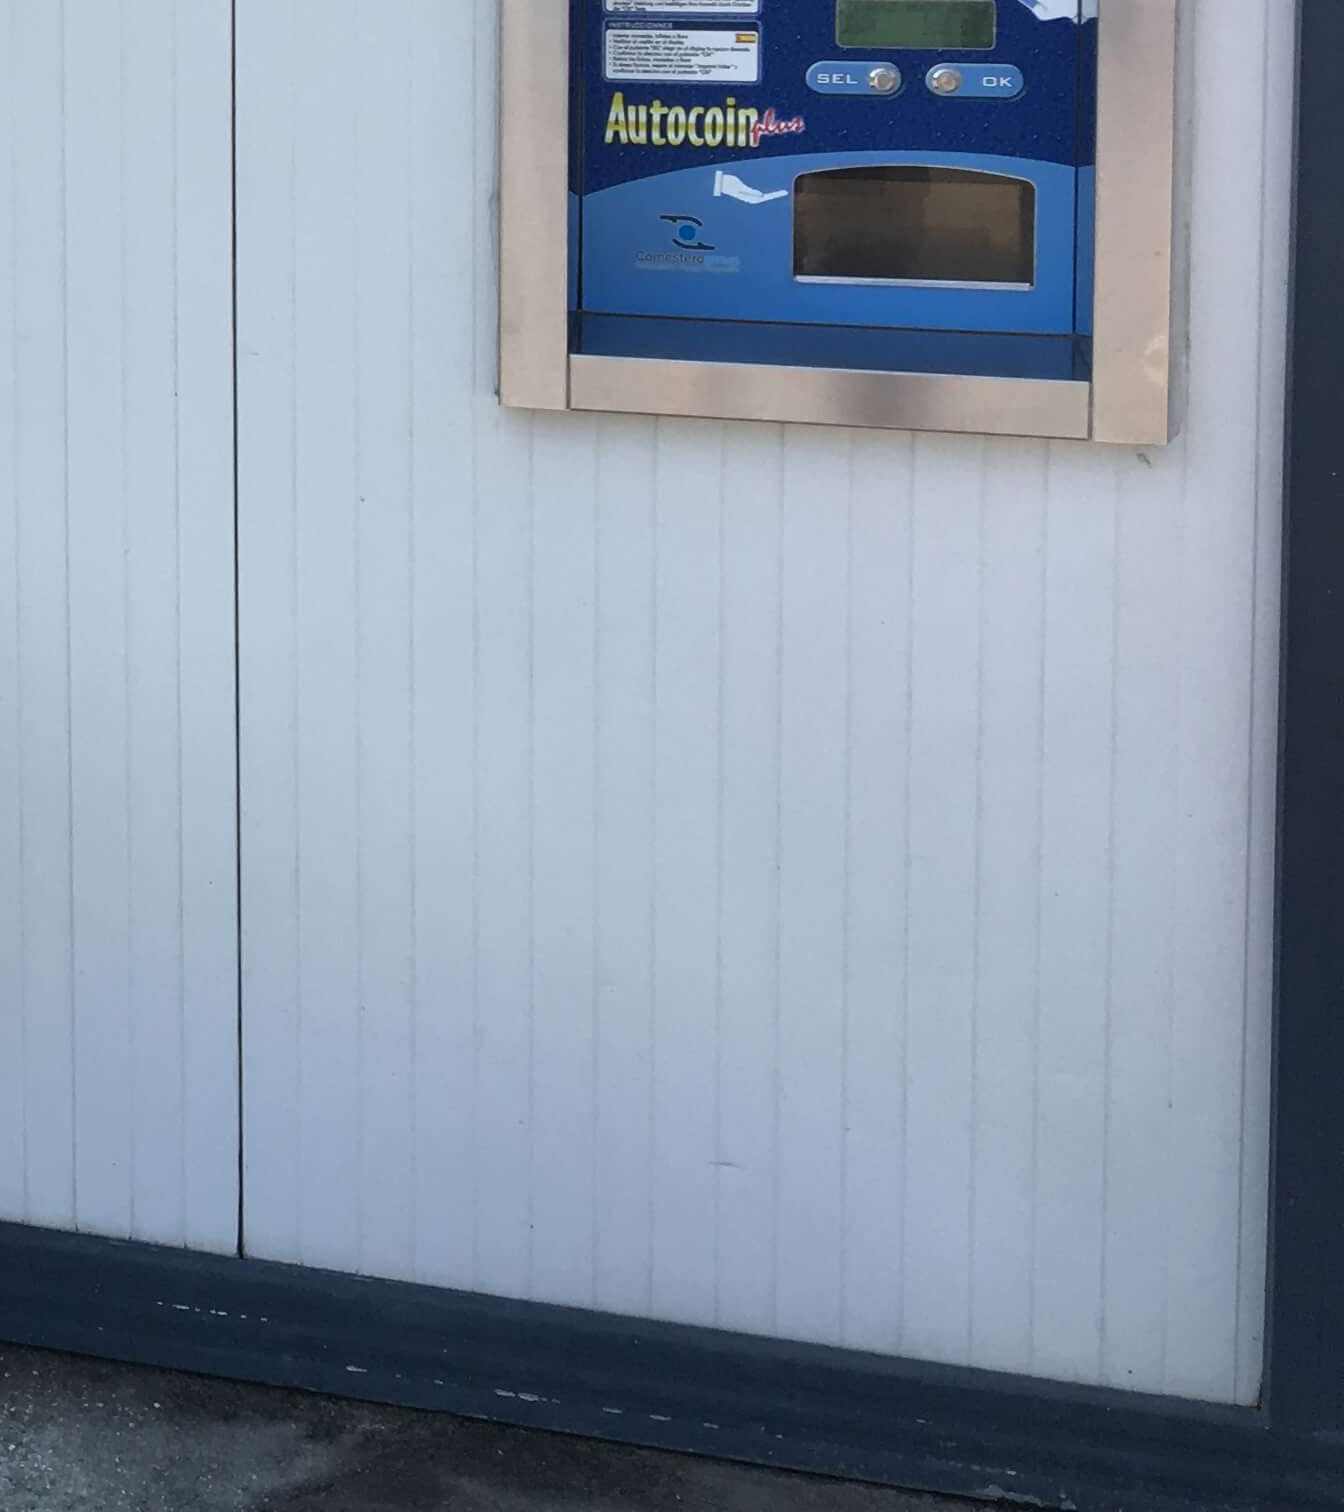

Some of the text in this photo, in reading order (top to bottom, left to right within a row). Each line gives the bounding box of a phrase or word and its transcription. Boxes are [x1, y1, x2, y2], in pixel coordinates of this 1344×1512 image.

[817, 73, 1013, 87] SEL OK
[604, 91, 806, 148] Autocoin plus
